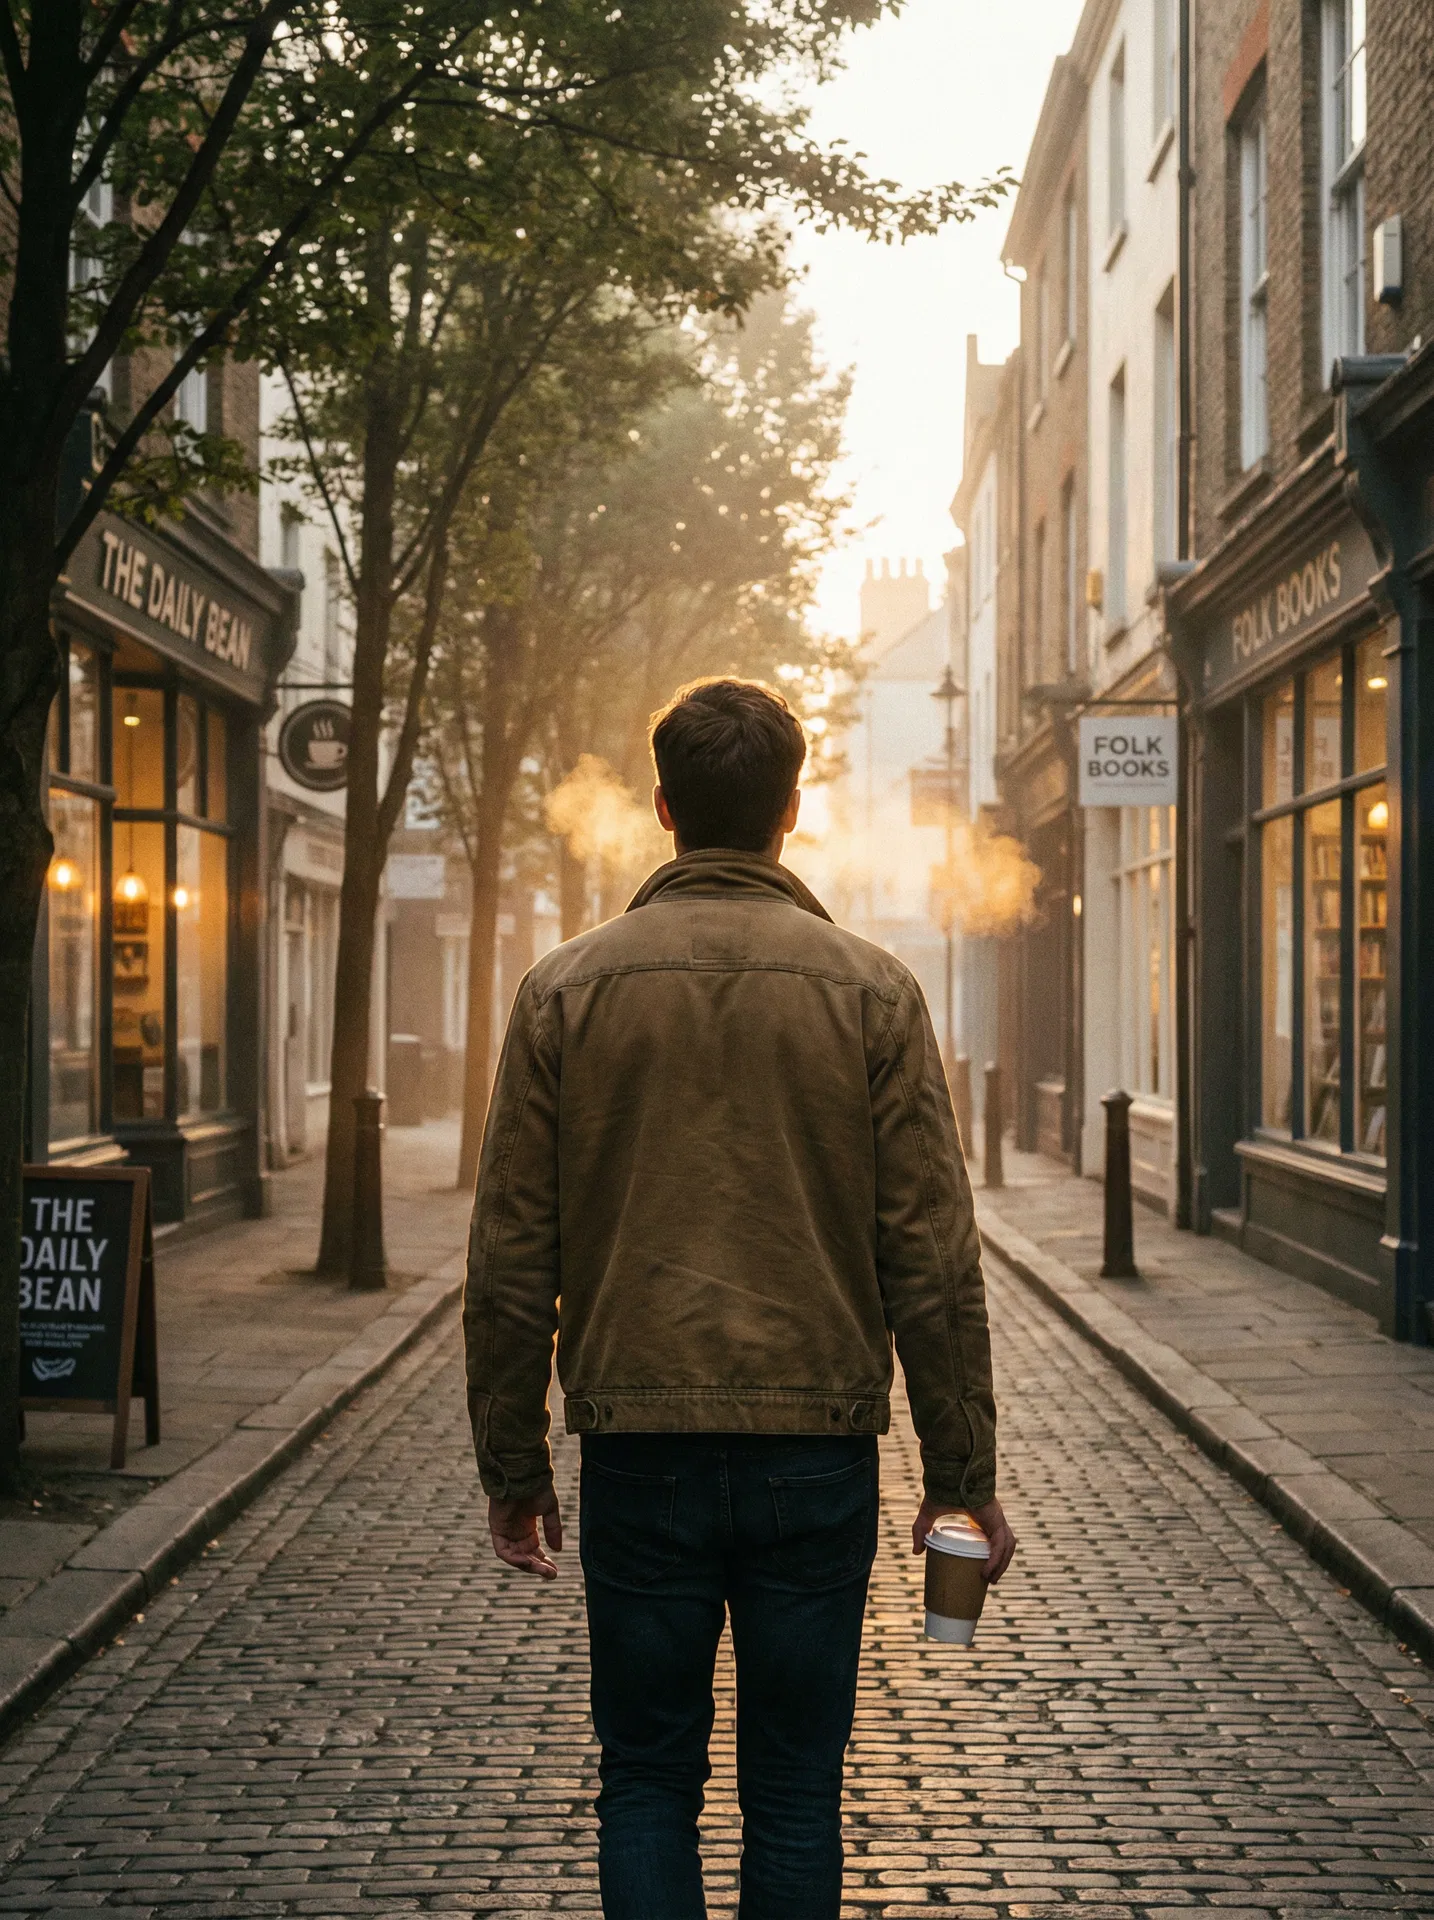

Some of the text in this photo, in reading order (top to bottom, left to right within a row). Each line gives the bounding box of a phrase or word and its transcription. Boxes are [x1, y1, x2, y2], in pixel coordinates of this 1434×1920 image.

[103, 530, 251, 671] THE DAILY BEAN
[1232, 541, 1341, 664] FOLK BOOKS
[1094, 735, 1163, 755] FOLK
[1087, 760, 1169, 777] BOOKS
[30, 1197, 95, 1233] THE
[19, 1276, 102, 1313] BEAN
